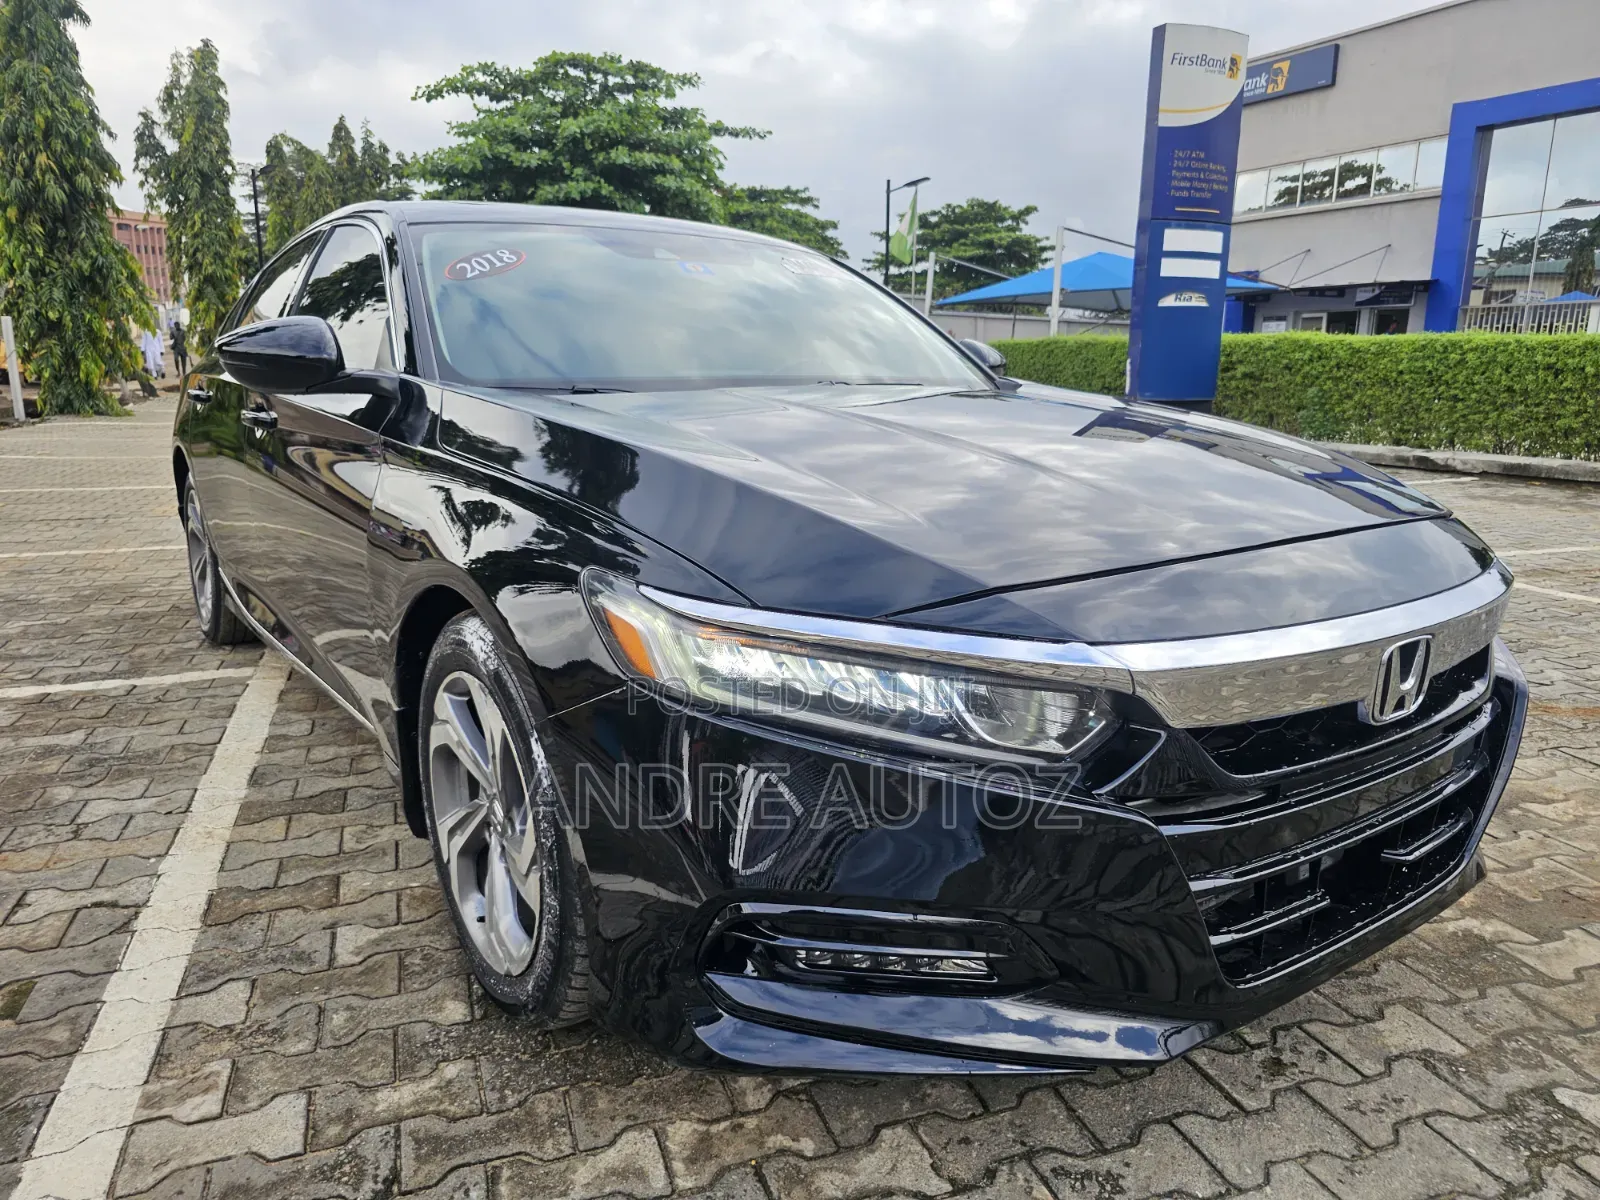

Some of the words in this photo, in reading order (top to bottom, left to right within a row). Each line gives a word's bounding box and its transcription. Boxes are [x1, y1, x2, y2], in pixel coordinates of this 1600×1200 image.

[1171, 52, 1227, 69] FirstBank
[1174, 150, 1190, 158] 24/7
[1191, 151, 1205, 159] ATM
[1173, 160, 1190, 168] 24/7
[1171, 170, 1199, 179] Payments
[1171, 179, 1191, 188] Mobile
[1192, 180, 1209, 190] Money
[1170, 189, 1189, 197] Funds
[1190, 190, 1212, 199] Transfer
[456, 249, 517, 278] 2018
[1174, 293, 1193, 302] Ria
